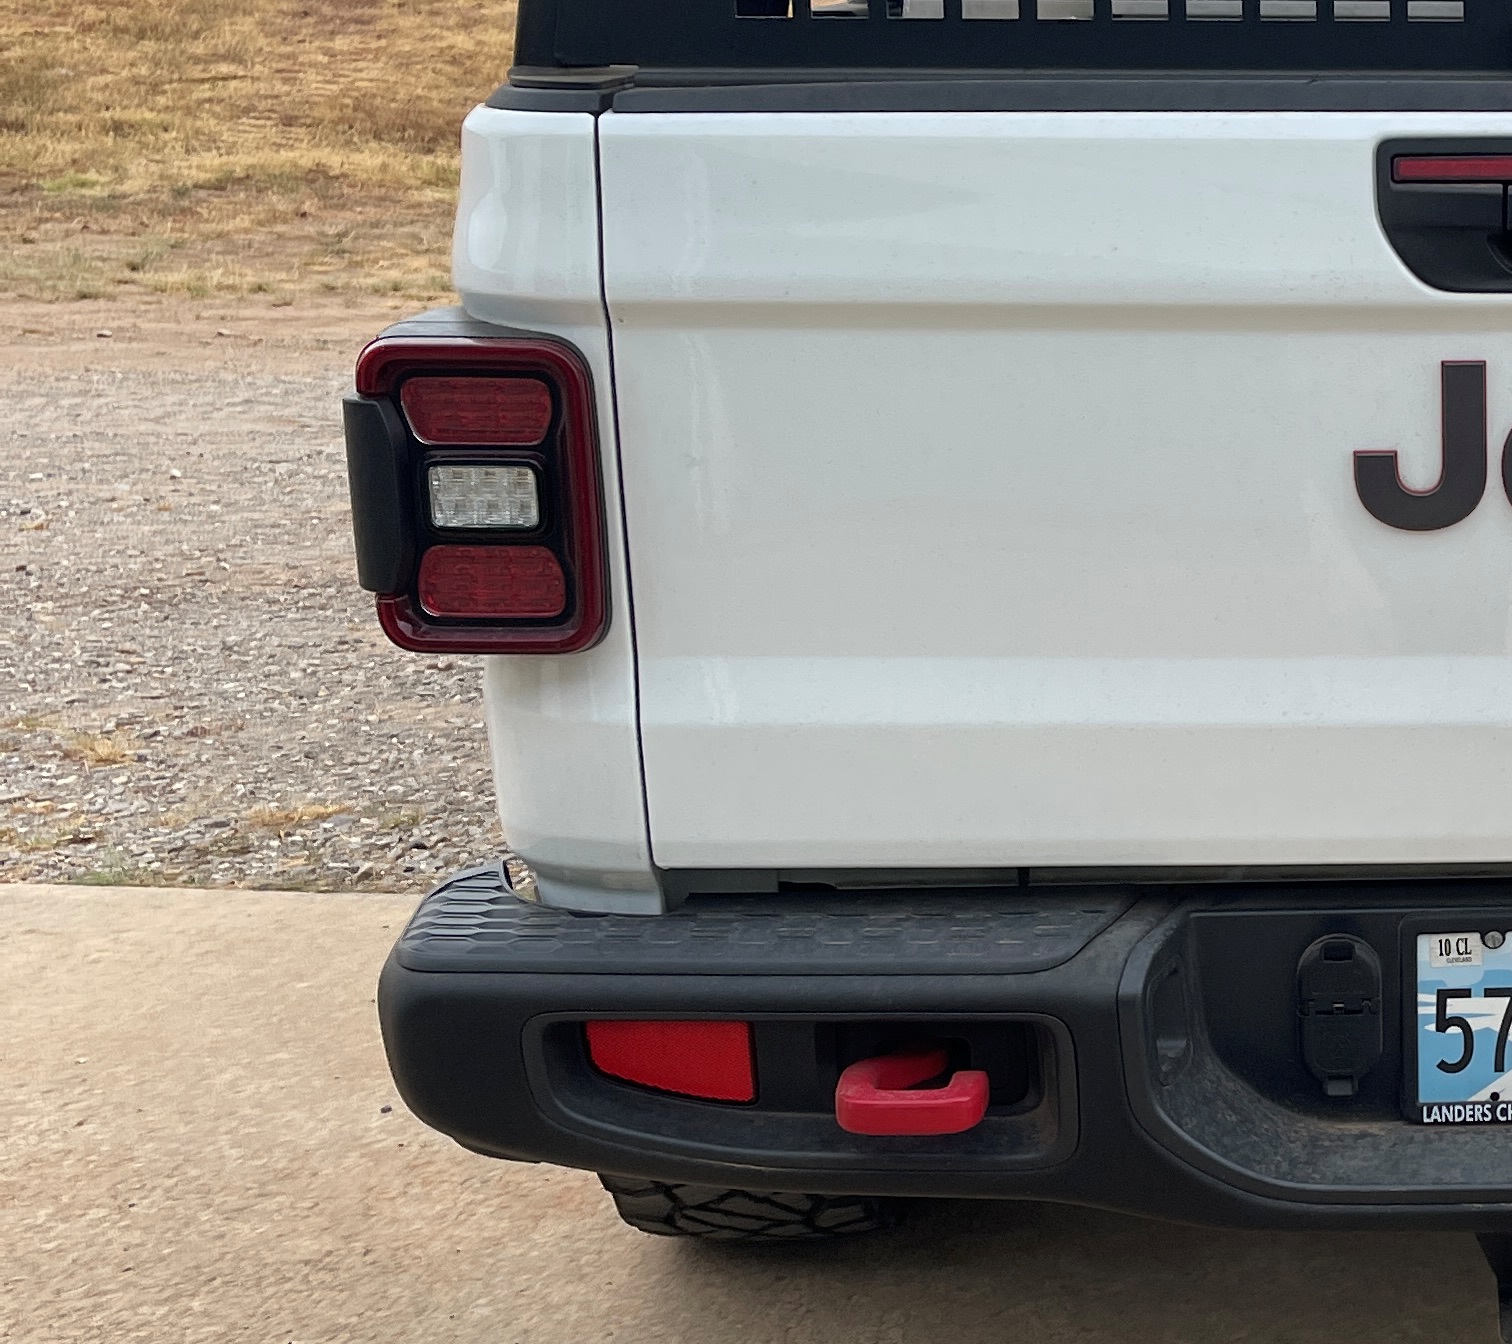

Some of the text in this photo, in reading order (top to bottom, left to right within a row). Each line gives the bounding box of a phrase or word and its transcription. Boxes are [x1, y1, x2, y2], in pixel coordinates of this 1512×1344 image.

[1438, 937, 1472, 956] 10 CL
[1422, 1104, 1492, 1123] LANDERS
